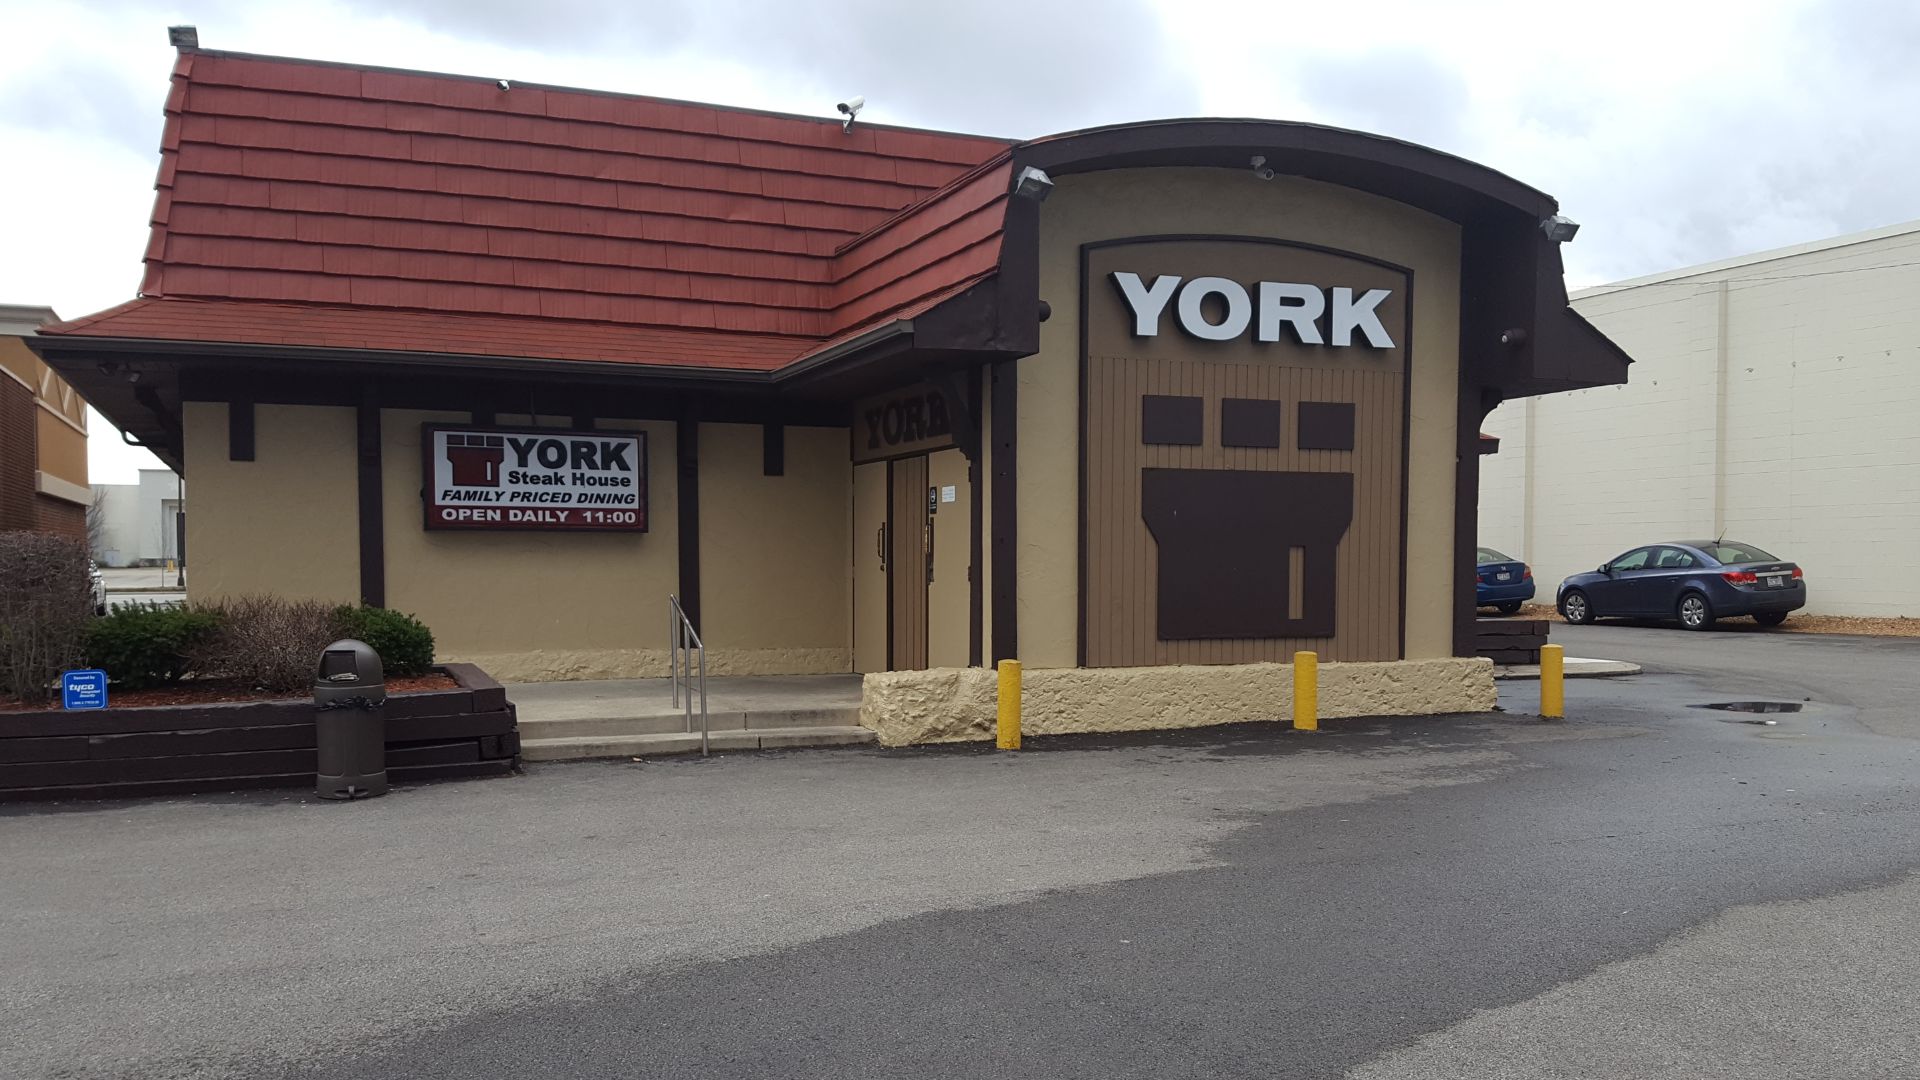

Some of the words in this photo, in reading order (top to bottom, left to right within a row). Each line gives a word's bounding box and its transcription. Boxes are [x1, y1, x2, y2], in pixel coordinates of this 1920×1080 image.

[1109, 271, 1396, 348] YORK
[507, 437, 631, 471] YORK
[508, 471, 566, 486] Steak
[571, 473, 631, 488] House
[441, 490, 505, 502] FAMILY
[509, 491, 572, 504] PRICED
[576, 493, 636, 505] DINING
[441, 508, 501, 521] OPEN
[509, 509, 569, 522] DAILY
[582, 511, 636, 523] 11:00
[69, 684, 95, 692] tyco
